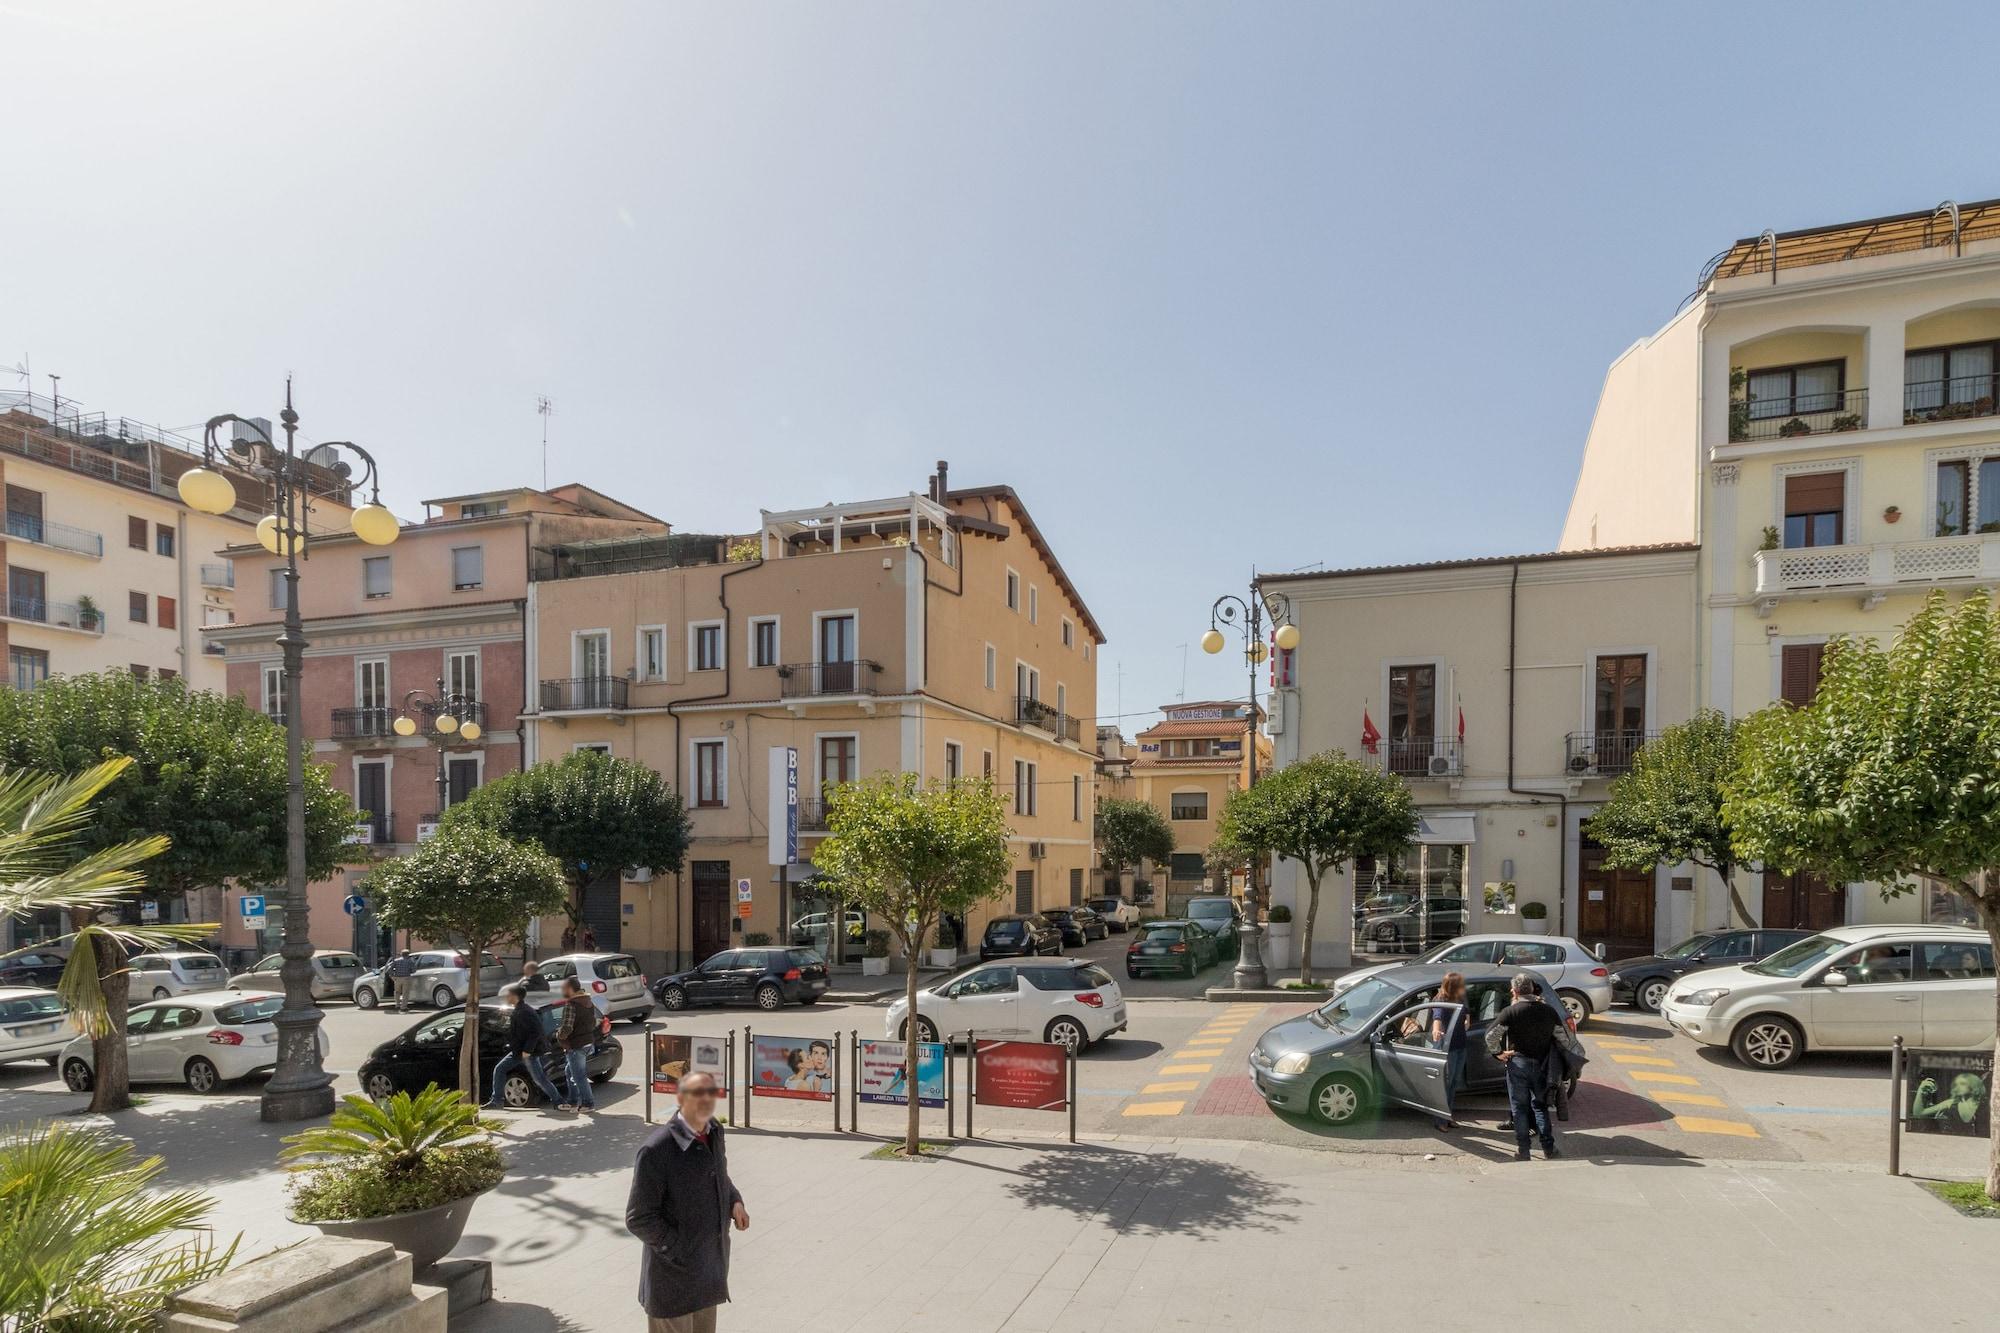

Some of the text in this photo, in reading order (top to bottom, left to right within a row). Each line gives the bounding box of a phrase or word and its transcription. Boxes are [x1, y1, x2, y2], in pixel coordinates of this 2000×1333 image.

[1172, 708, 1221, 720] NUOVA GESTIONE
[1141, 743, 1160, 752] B&B
[245, 898, 260, 915] P
[918, 1048, 940, 1058] ULITI
